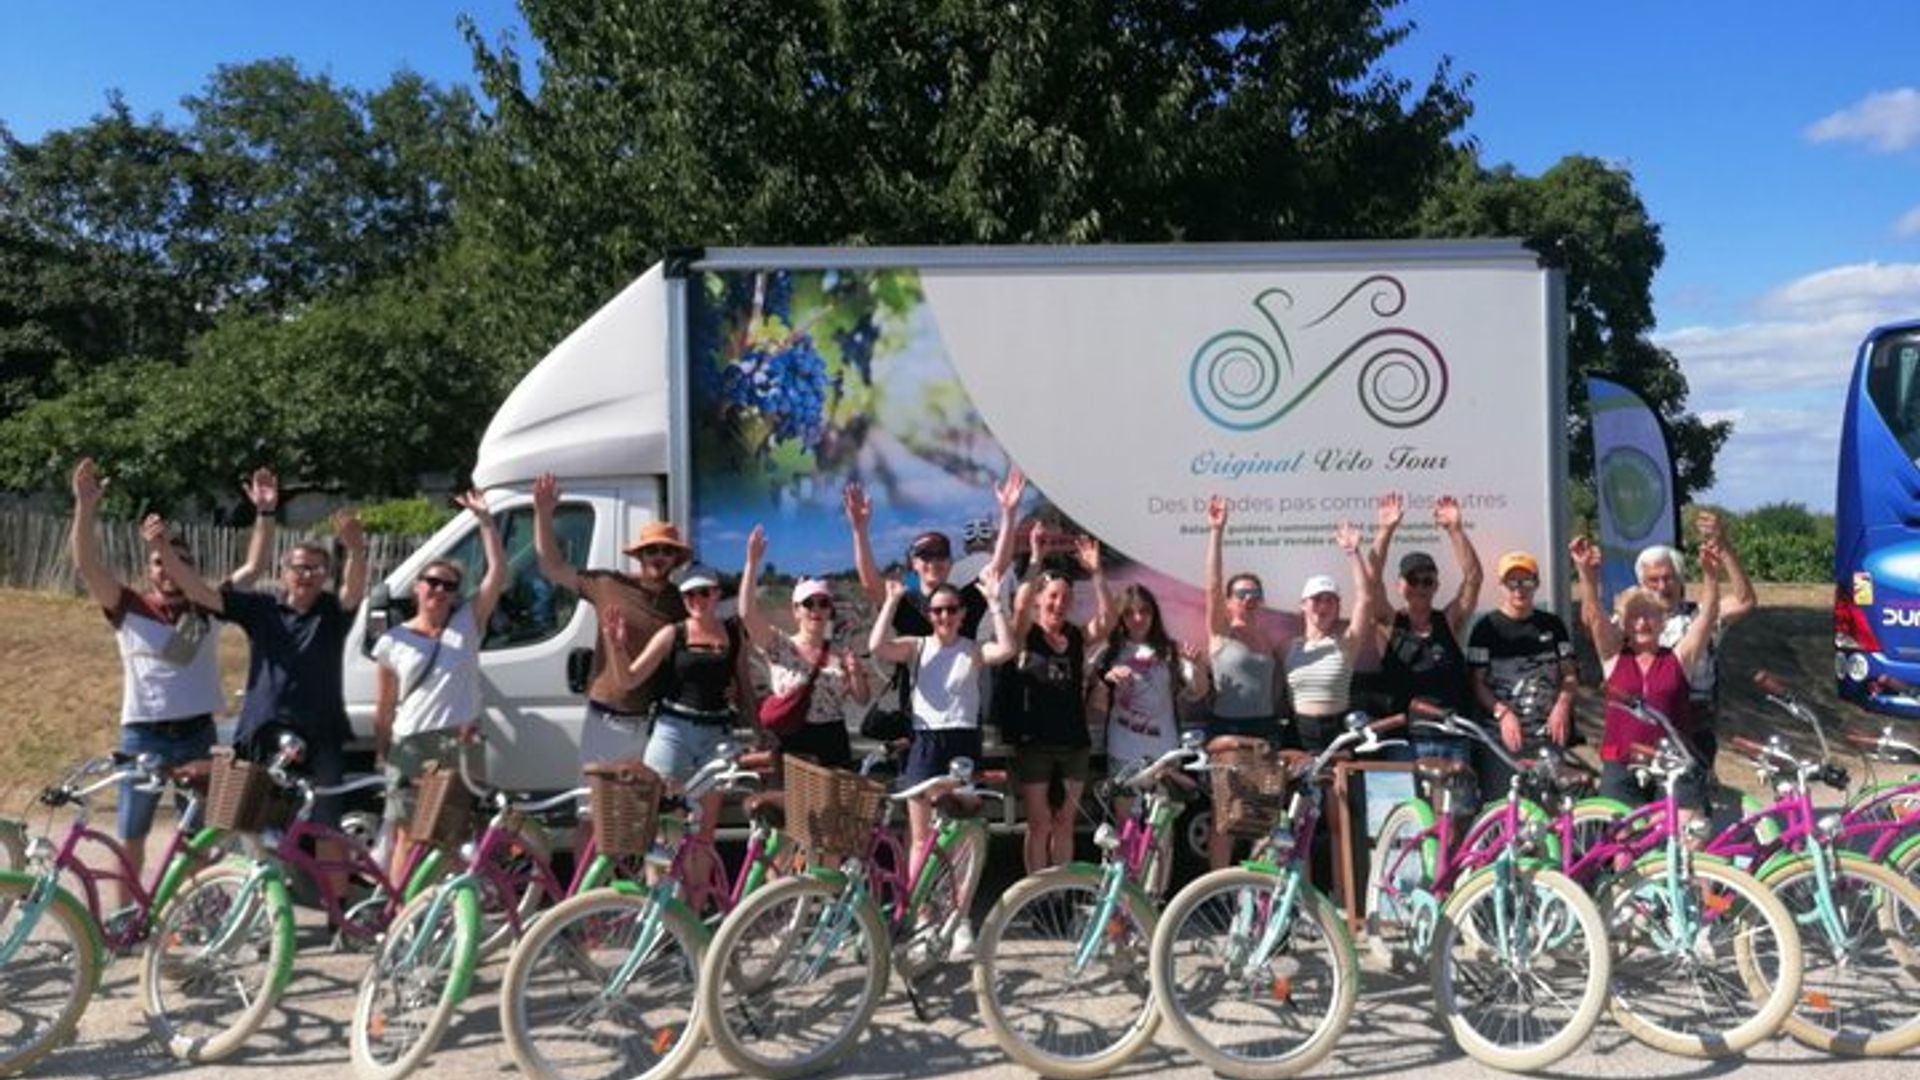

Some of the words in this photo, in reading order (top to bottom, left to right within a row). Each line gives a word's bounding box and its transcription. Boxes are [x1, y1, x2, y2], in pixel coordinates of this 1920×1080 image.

[1190, 450, 1304, 480] Original
[1313, 447, 1374, 472] Vélo
[1384, 445, 1449, 471] Tour
[1149, 497, 1188, 514] Des
[1280, 497, 1316, 514] pas
